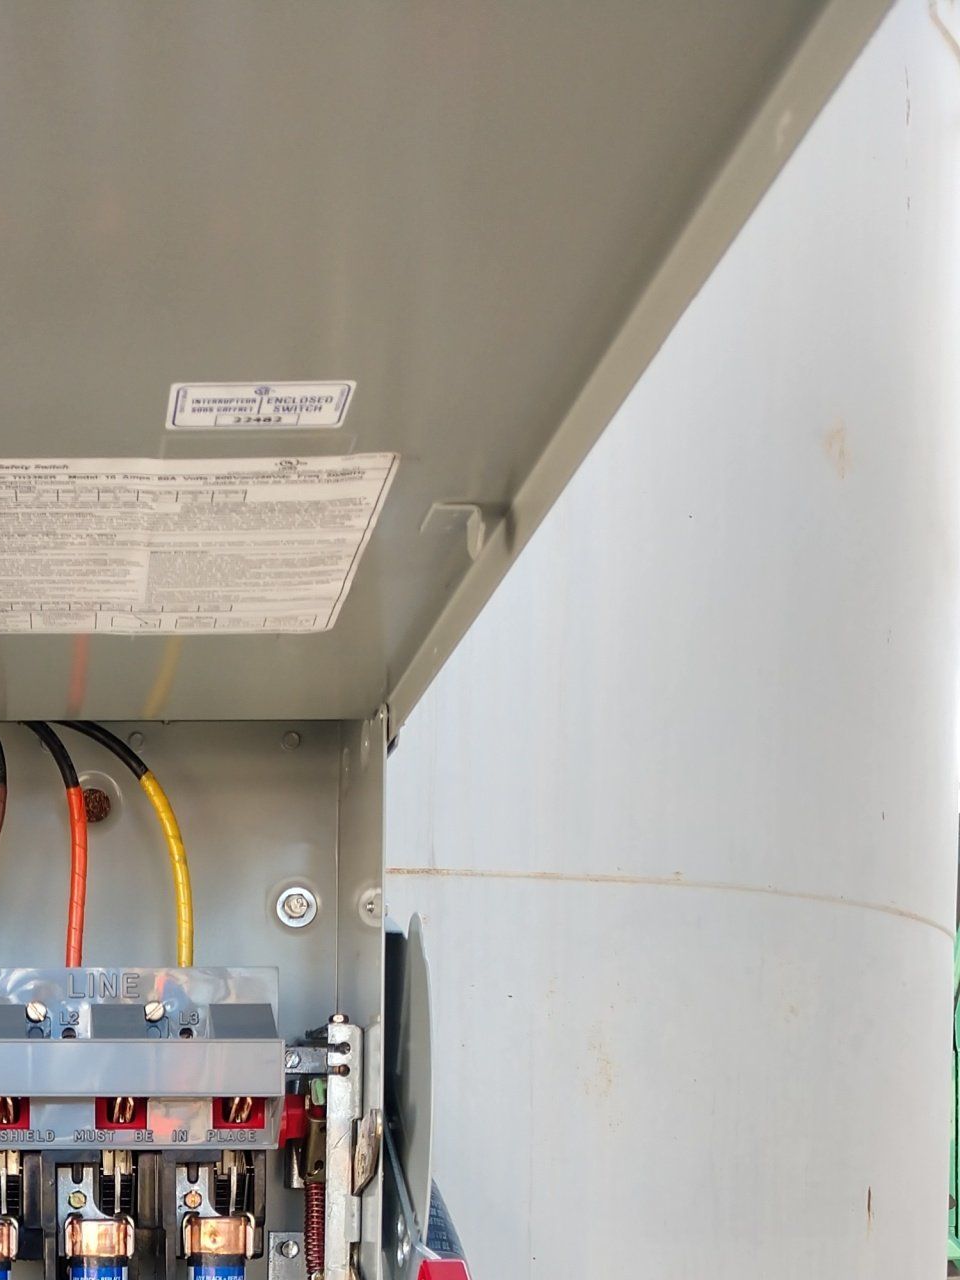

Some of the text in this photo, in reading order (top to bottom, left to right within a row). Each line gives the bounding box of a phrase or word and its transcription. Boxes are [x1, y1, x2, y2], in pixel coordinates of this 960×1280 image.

[266, 396, 333, 404] ENCLOSED
[272, 405, 322, 413] SWITCH
[67, 972, 141, 999] LINE
[59, 1011, 79, 1026] L2
[178, 1011, 200, 1026] L3
[0, 1129, 56, 1142] SHIELD
[73, 1129, 115, 1142] MUST
[134, 1130, 154, 1142] BE
[172, 1130, 188, 1142] IN
[207, 1130, 257, 1142] PLACE
